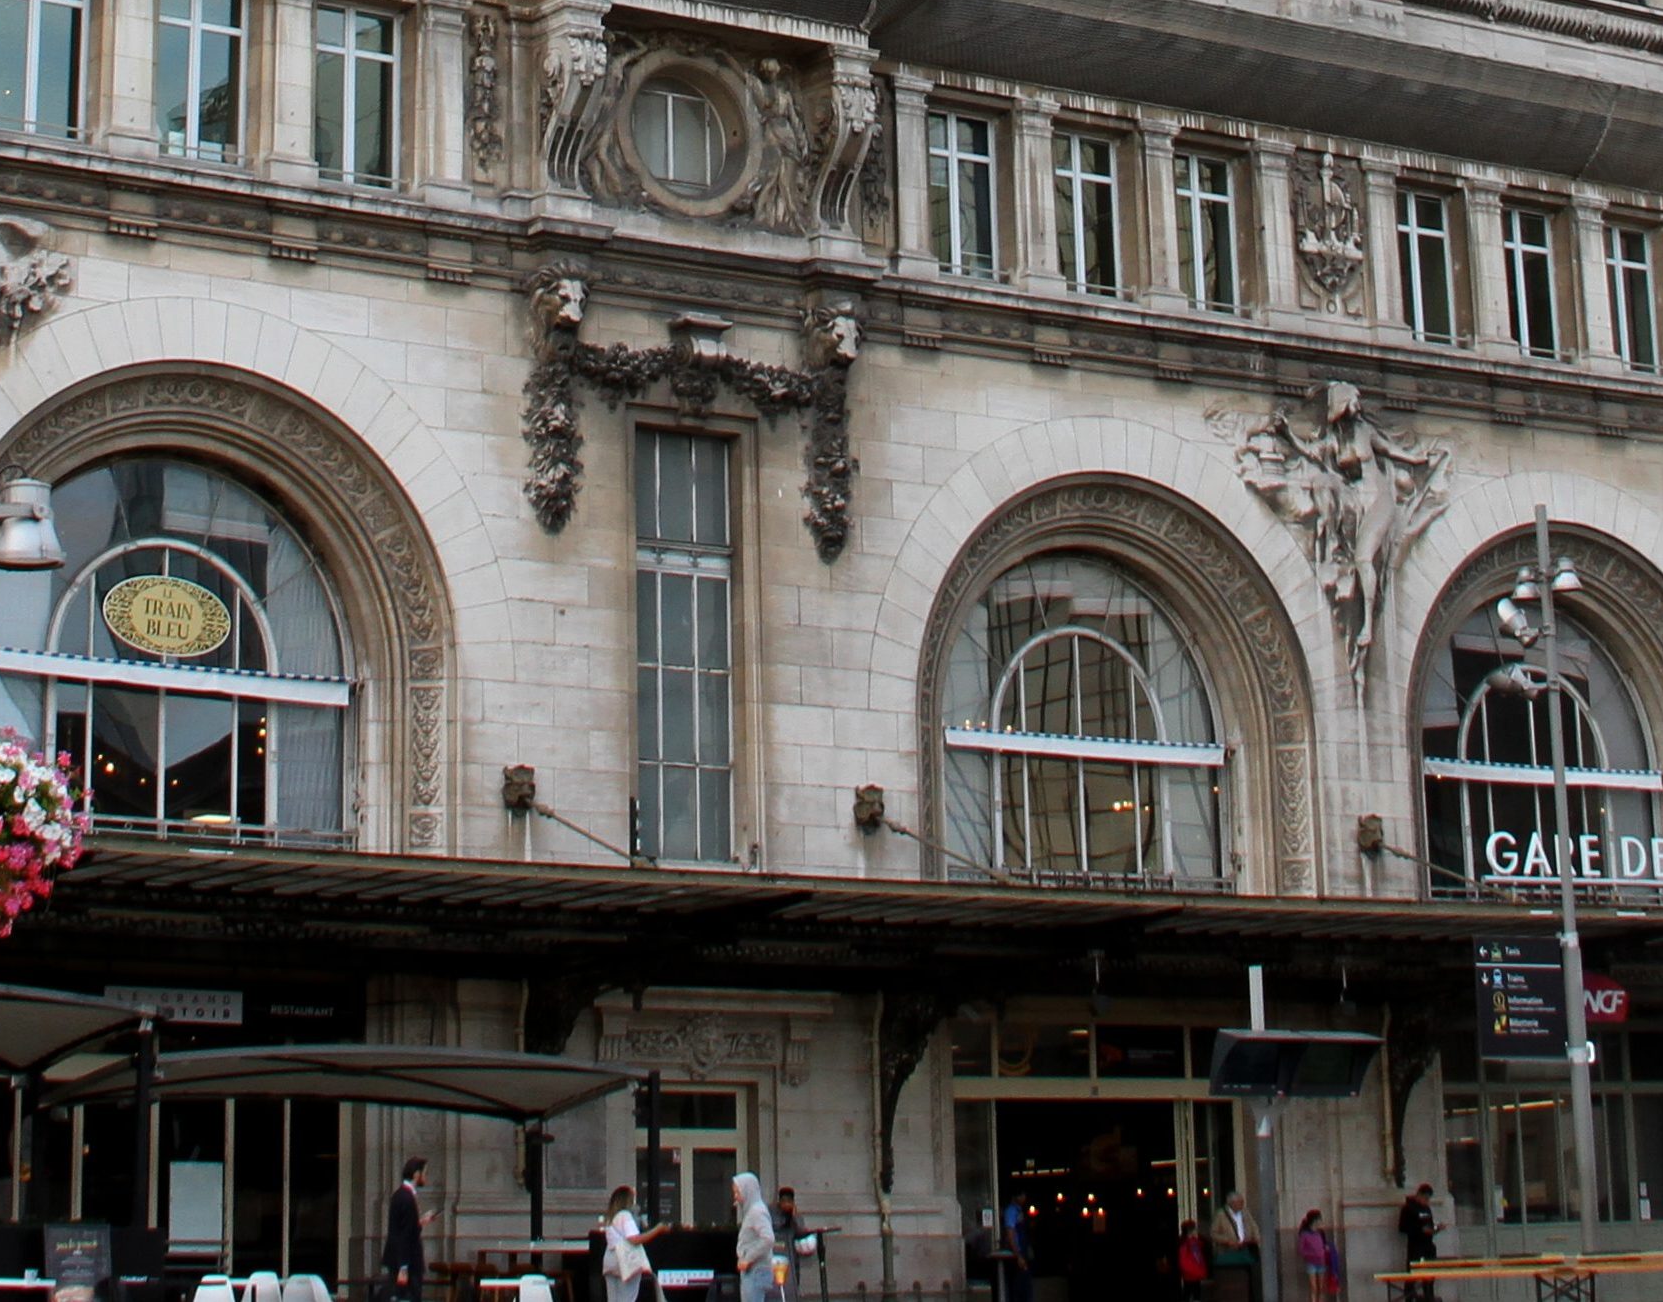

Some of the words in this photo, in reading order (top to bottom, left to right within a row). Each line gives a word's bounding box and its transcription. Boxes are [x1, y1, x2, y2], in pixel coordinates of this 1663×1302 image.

[143, 597, 195, 621] TRAIN
[146, 618, 191, 641] BLEU
[1505, 945, 1521, 957] Taxis
[269, 1004, 335, 1017] RESTAURANT
[1583, 989, 1626, 1014] NCF
